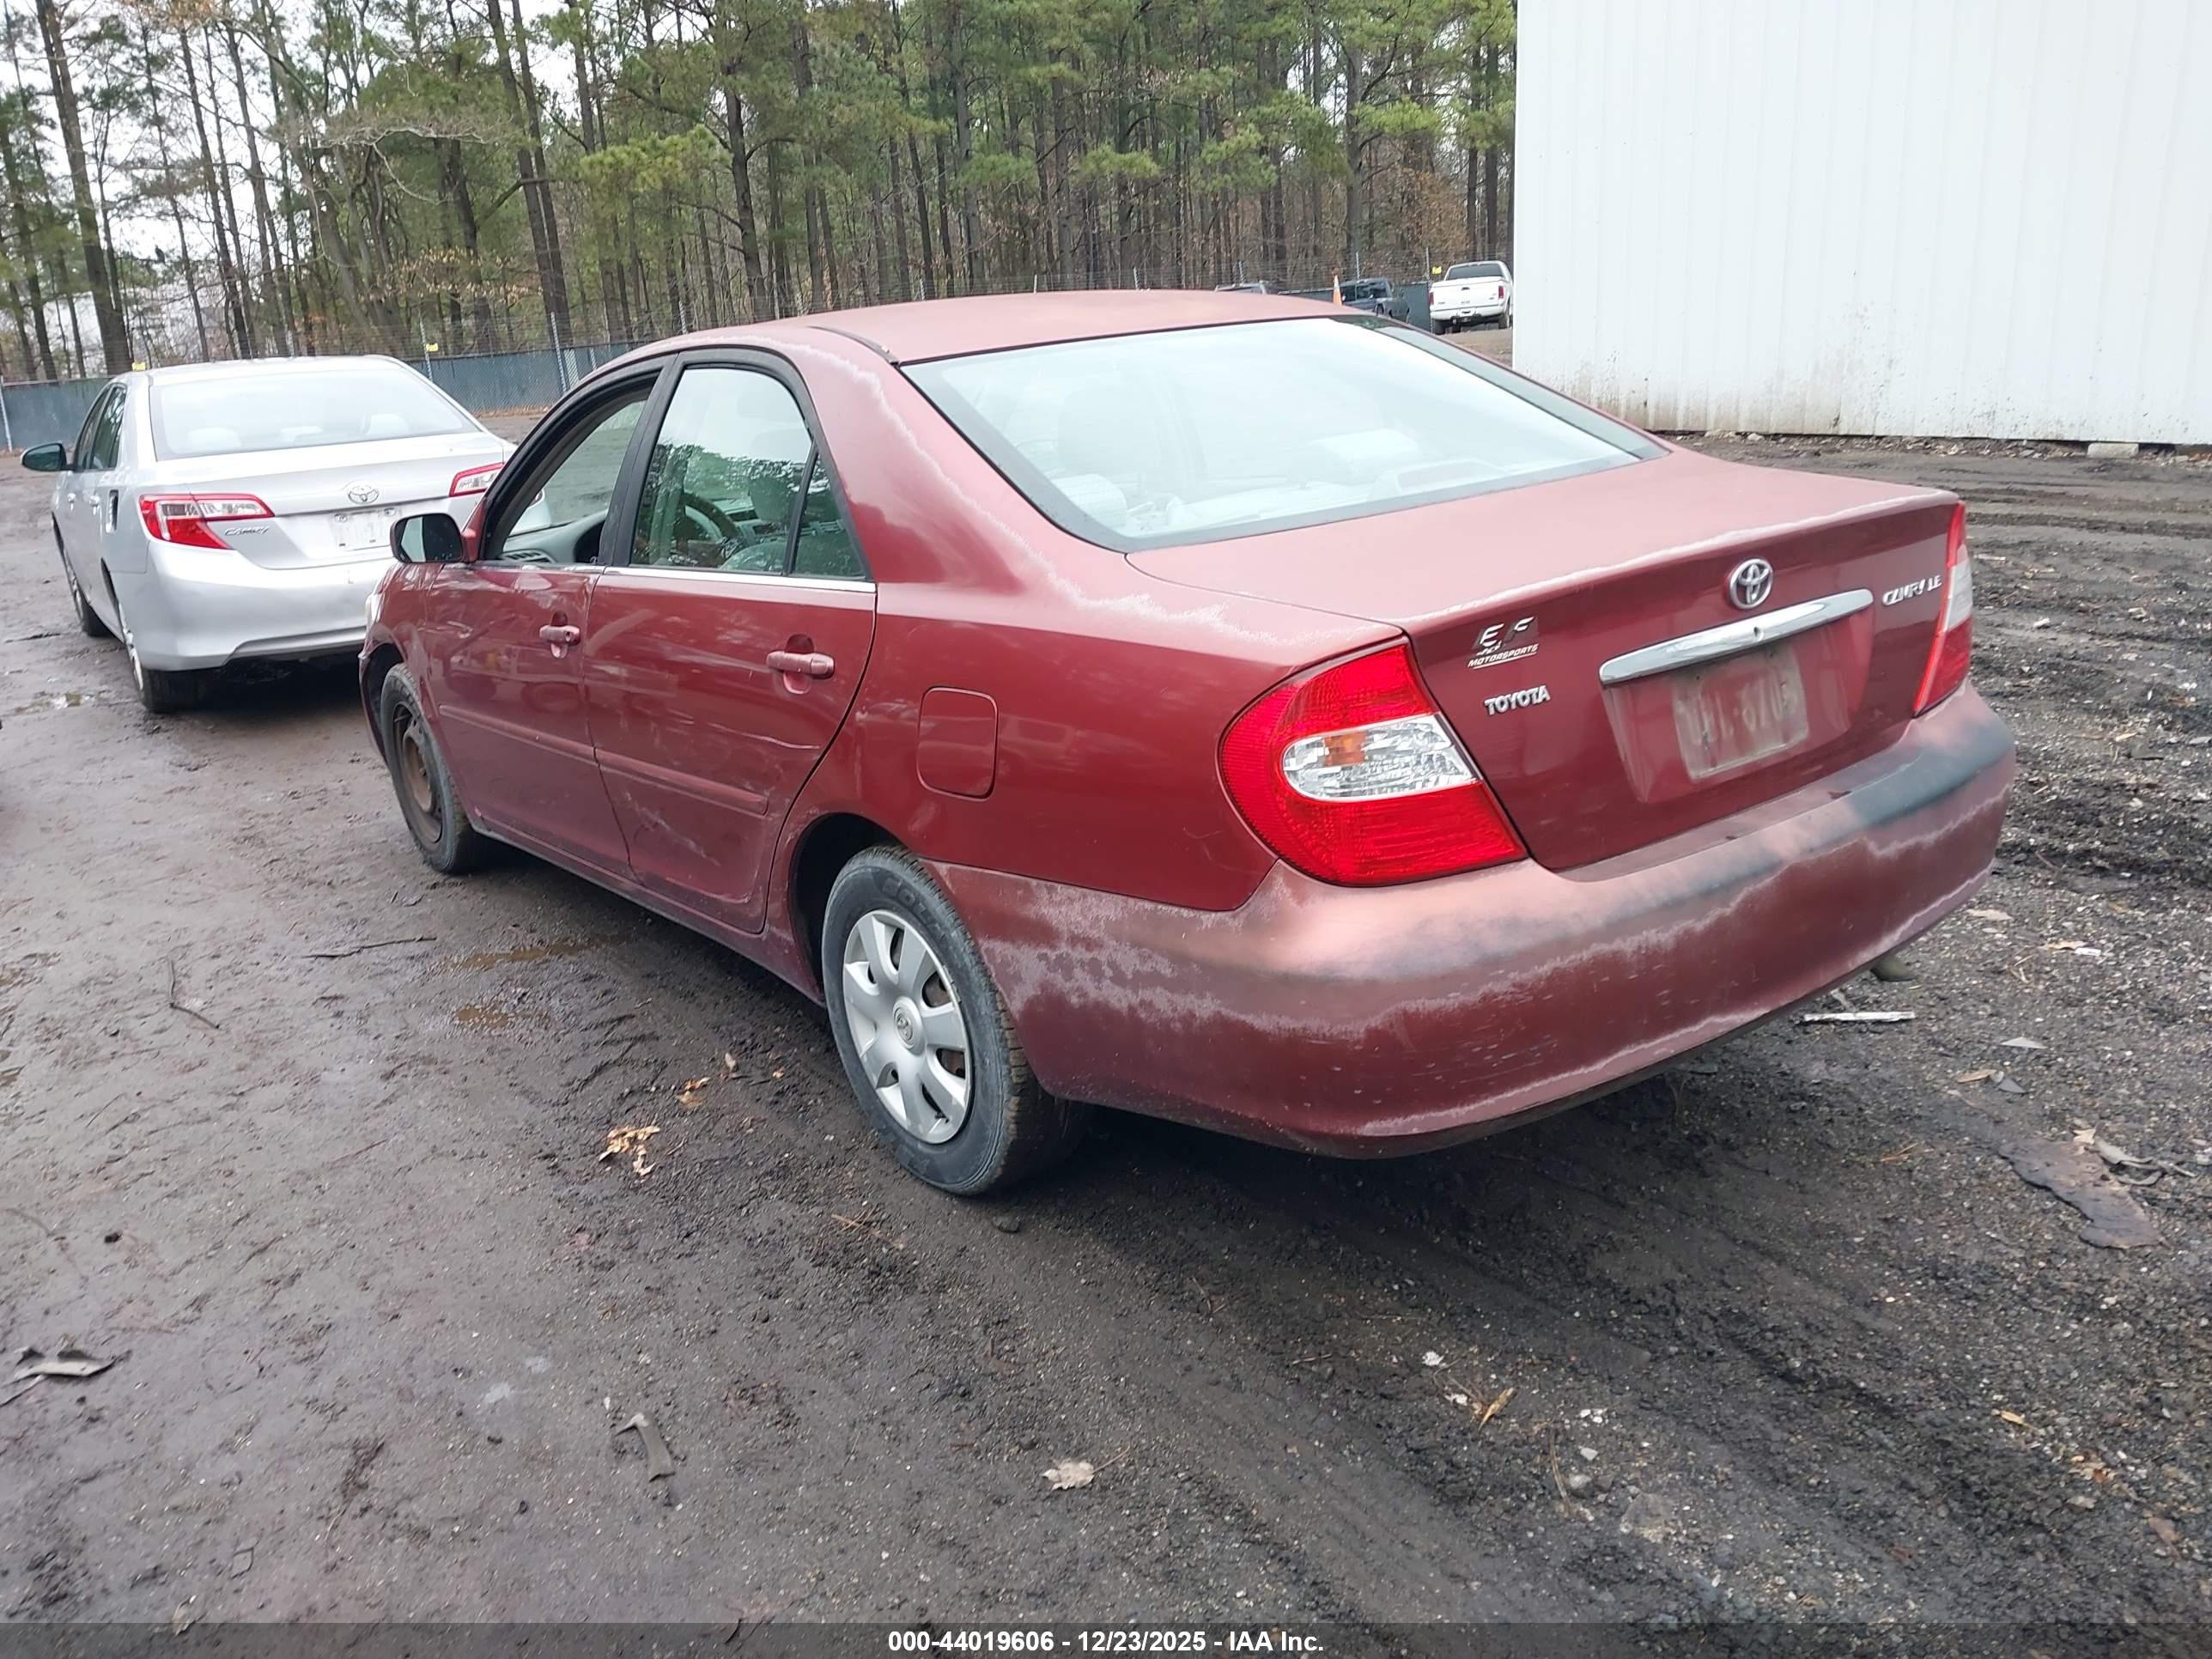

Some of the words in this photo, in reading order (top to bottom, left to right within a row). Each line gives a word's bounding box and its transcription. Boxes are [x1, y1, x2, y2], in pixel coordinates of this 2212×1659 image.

[1927, 574, 1942, 592] LE
[1467, 643, 1540, 668] MOTORSPORTS
[1484, 684, 1552, 715] TOYOTA
